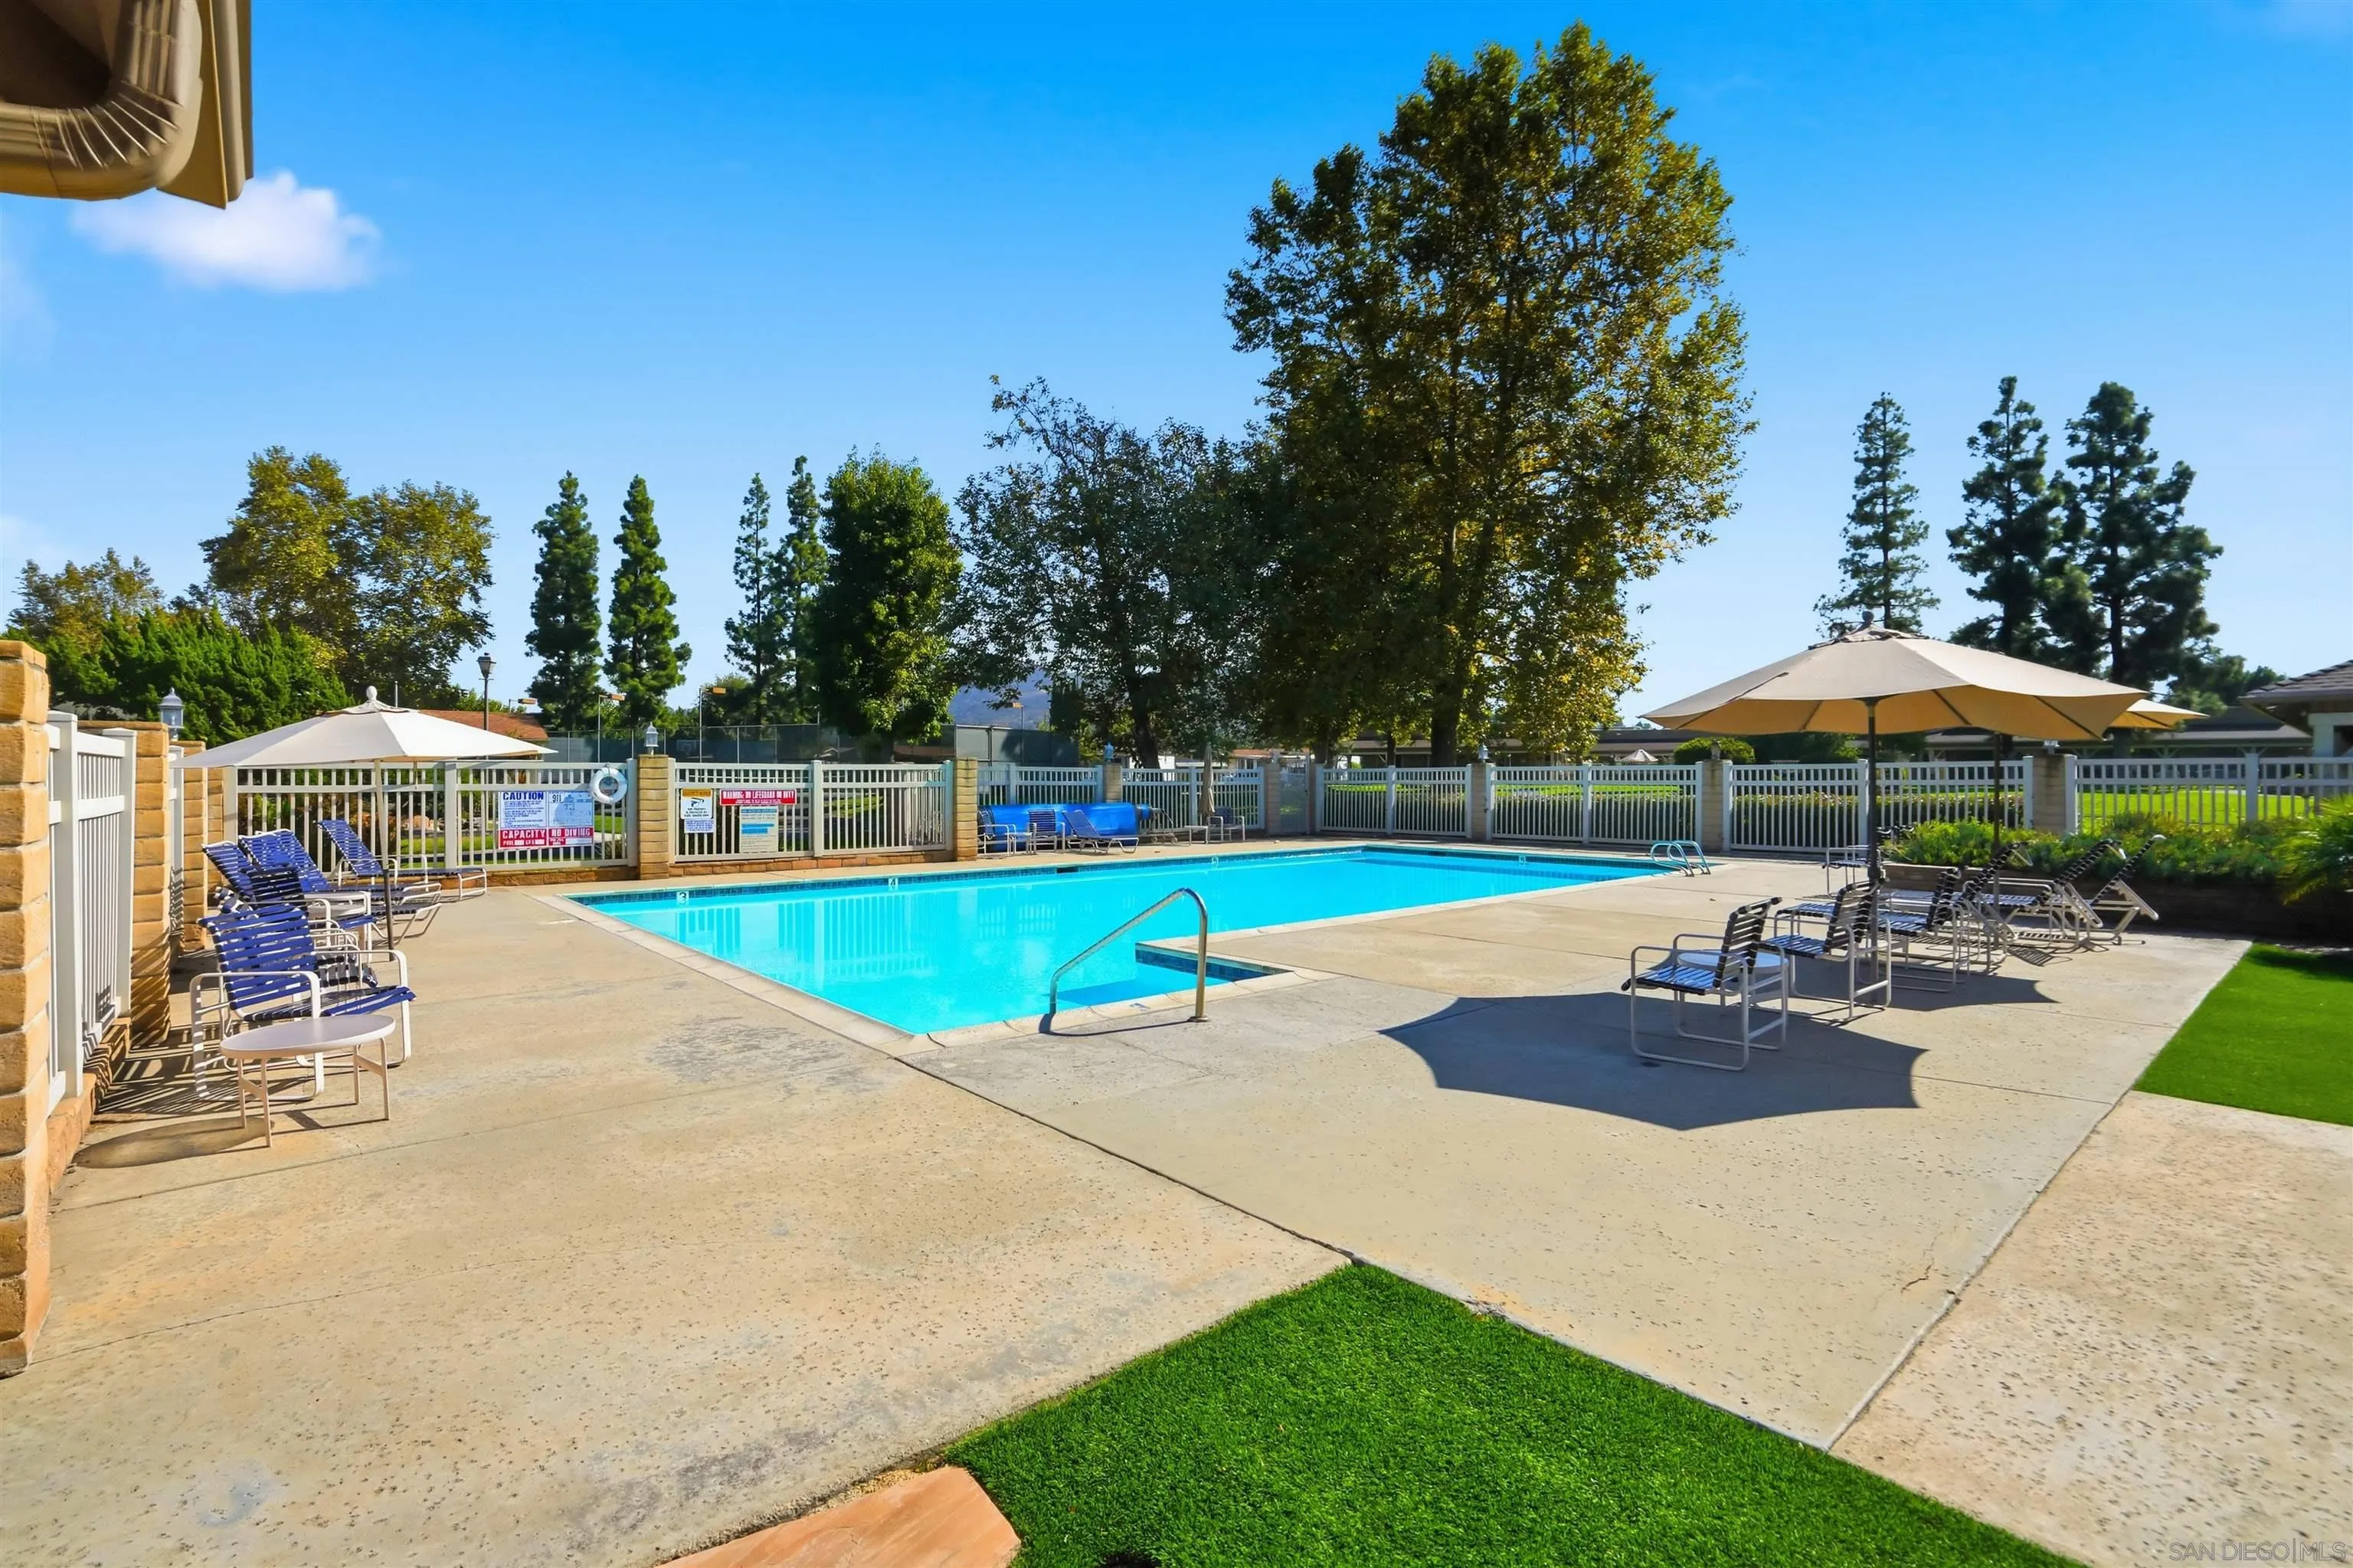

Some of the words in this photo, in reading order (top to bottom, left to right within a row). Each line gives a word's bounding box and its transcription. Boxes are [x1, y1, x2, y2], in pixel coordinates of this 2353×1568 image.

[502, 791, 544, 800] CAUTION
[552, 794, 561, 803] 911
[502, 830, 545, 839] CAPACITY
[551, 829, 563, 837] NO
[565, 828, 590, 836] DIVING
